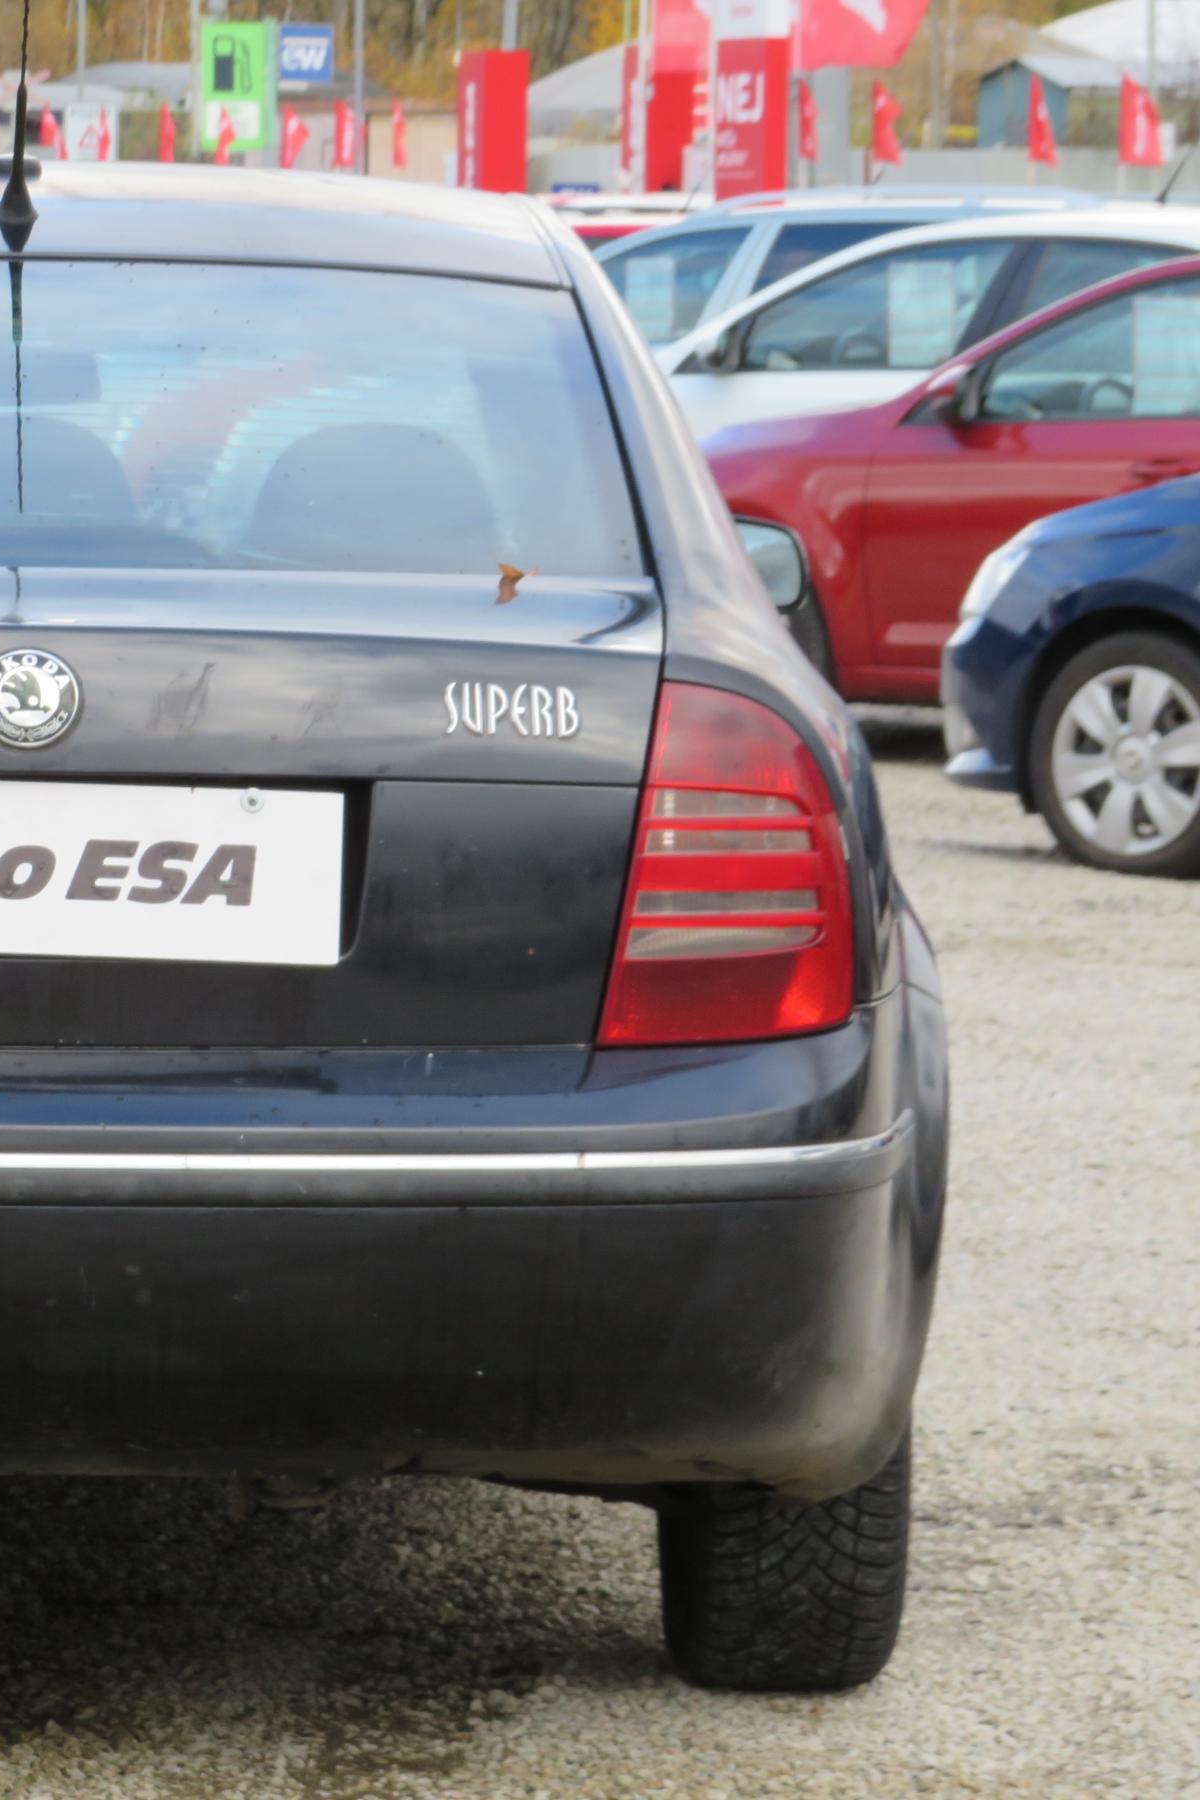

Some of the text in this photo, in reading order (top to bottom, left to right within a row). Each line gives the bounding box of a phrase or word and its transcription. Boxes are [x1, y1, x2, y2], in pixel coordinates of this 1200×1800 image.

[716, 72, 765, 123] NEJ
[444, 681, 580, 738] SUPERB
[64, 838, 258, 907] ESA
